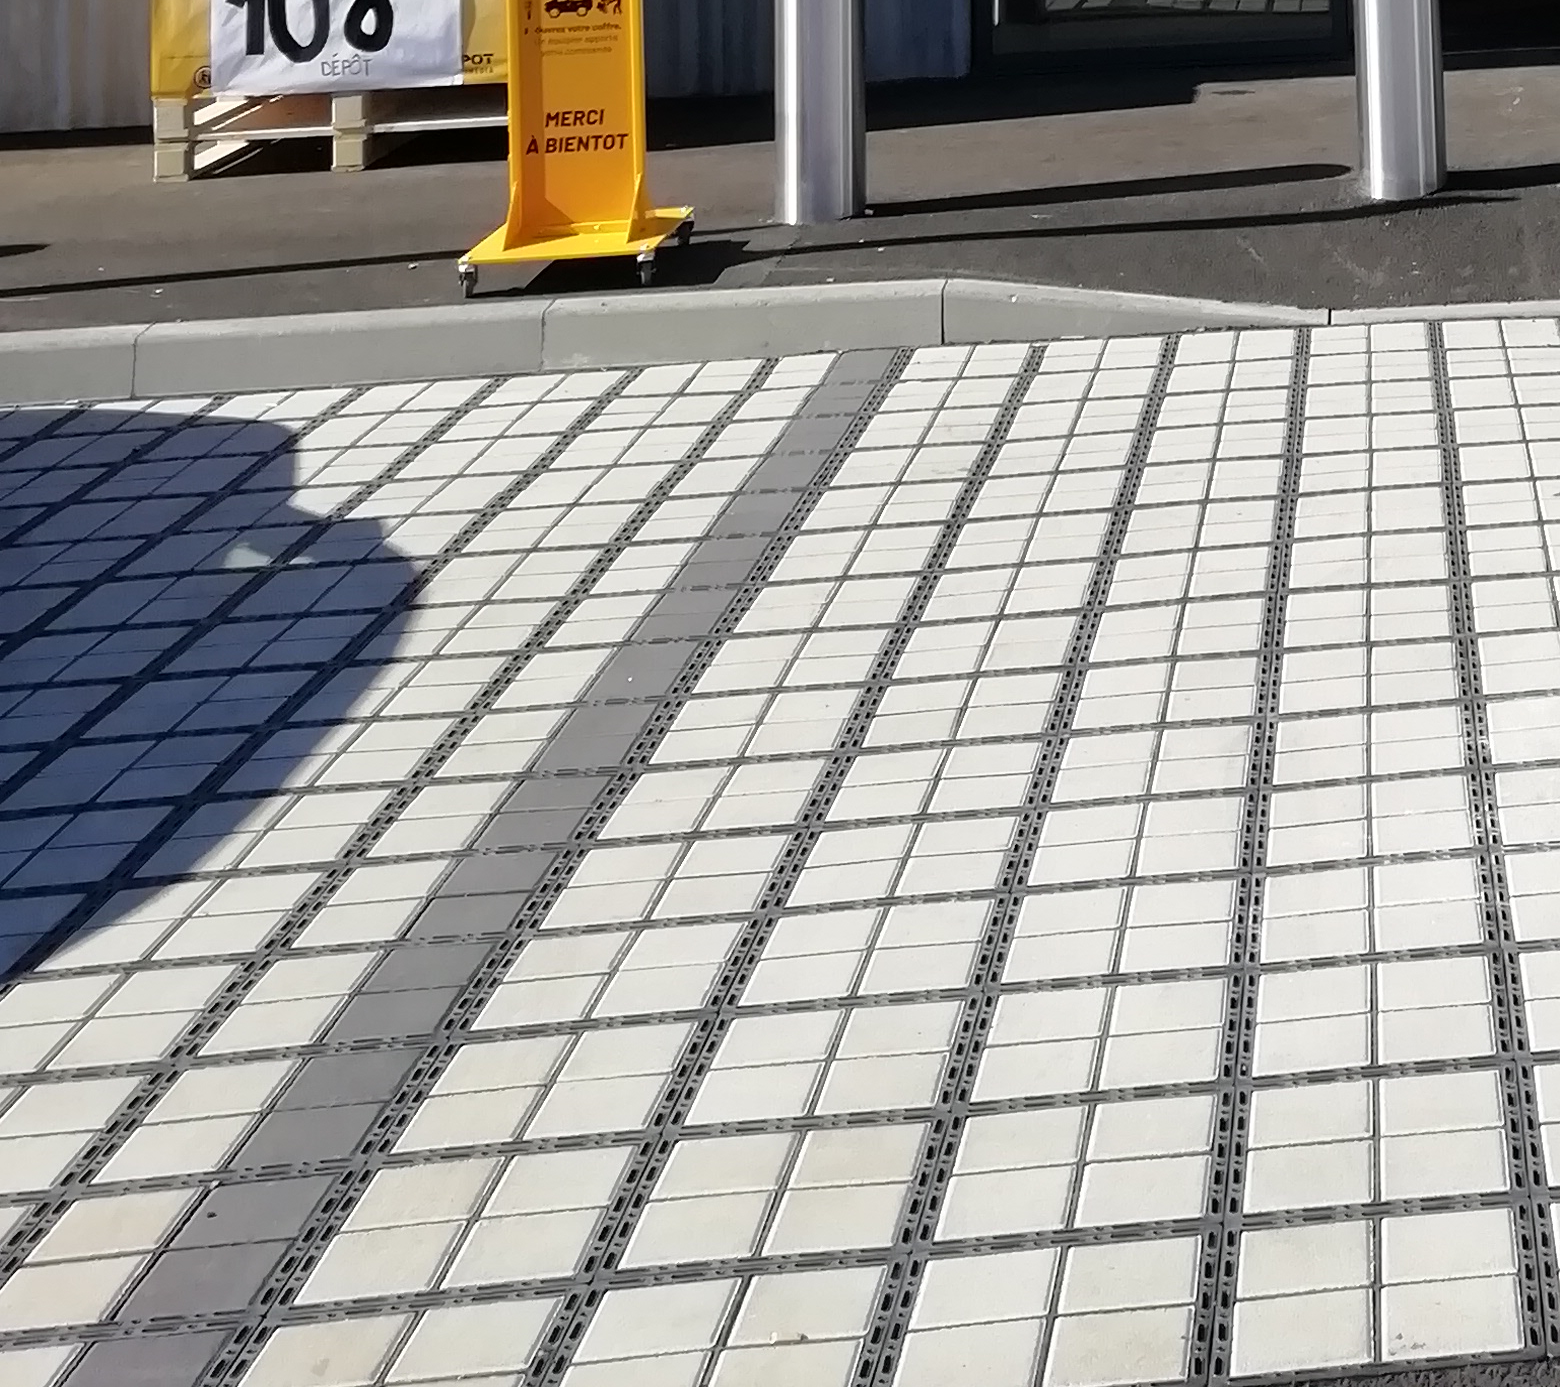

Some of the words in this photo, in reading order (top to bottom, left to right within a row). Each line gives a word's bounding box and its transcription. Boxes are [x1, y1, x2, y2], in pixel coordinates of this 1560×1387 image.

[320, 53, 374, 78] DÉPÔT
[544, 109, 605, 128] MERCI
[525, 134, 539, 156] À
[544, 132, 629, 155] BIENTOT
